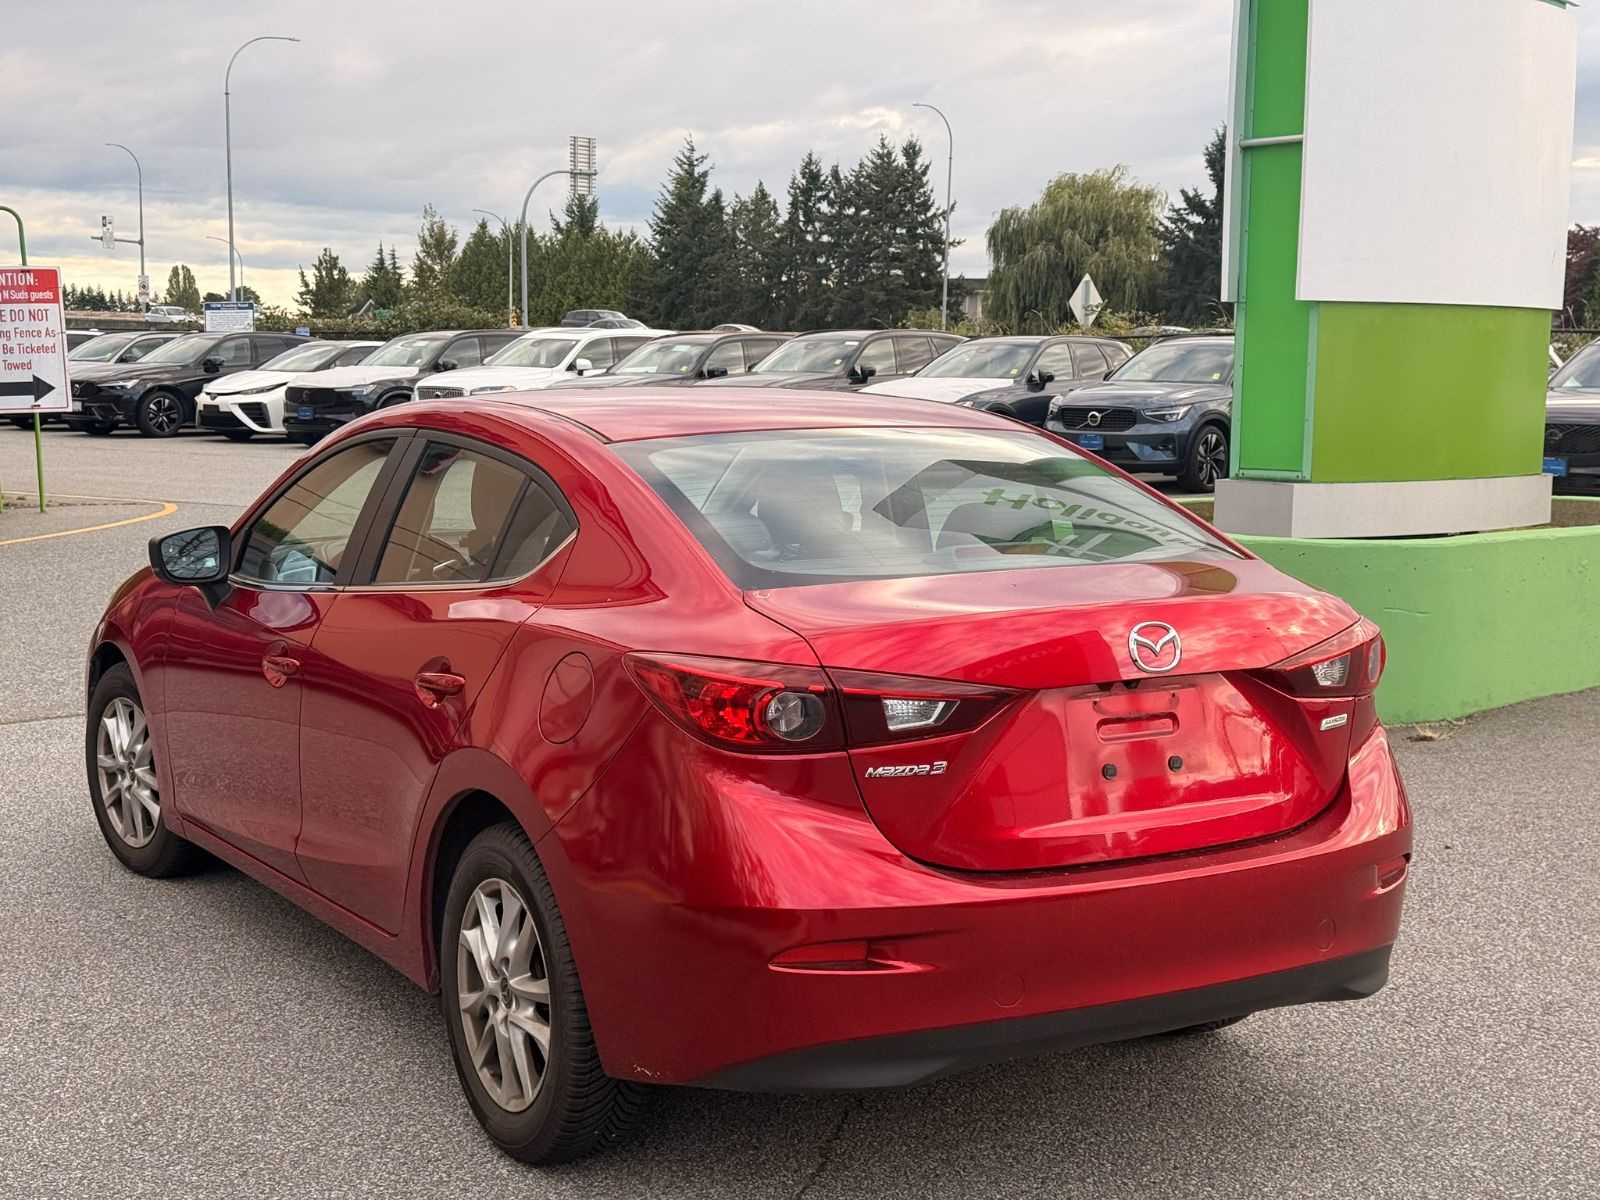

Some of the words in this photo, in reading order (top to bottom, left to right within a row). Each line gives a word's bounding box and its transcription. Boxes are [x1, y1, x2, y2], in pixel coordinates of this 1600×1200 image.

[3, 290, 9, 300] N
[10, 289, 29, 300] Suds
[30, 290, 54, 302] guests
[10, 309, 25, 322] DO
[28, 308, 49, 322] NOT
[14, 327, 42, 338] Fence
[45, 327, 56, 338] As
[2, 344, 14, 355] Be
[17, 343, 56, 354] Ticketed
[2, 359, 32, 371] Towed
